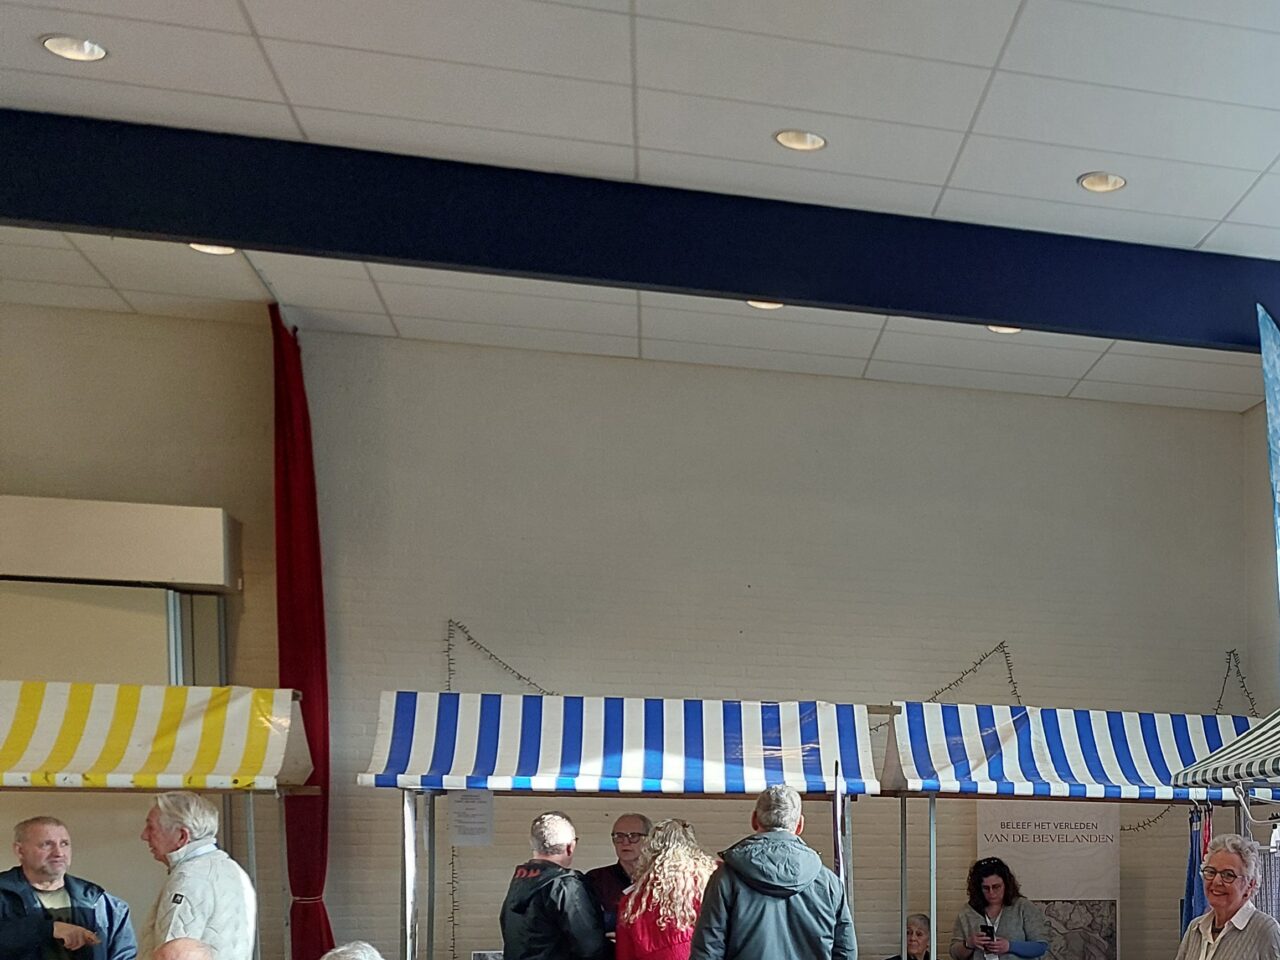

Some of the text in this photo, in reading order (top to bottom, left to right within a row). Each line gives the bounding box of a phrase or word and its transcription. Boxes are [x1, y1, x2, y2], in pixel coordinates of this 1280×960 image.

[1000, 821, 1098, 830] BELEEF HET VERLEDEN
[983, 833, 1114, 843] VAN DE BEVELANDEN
